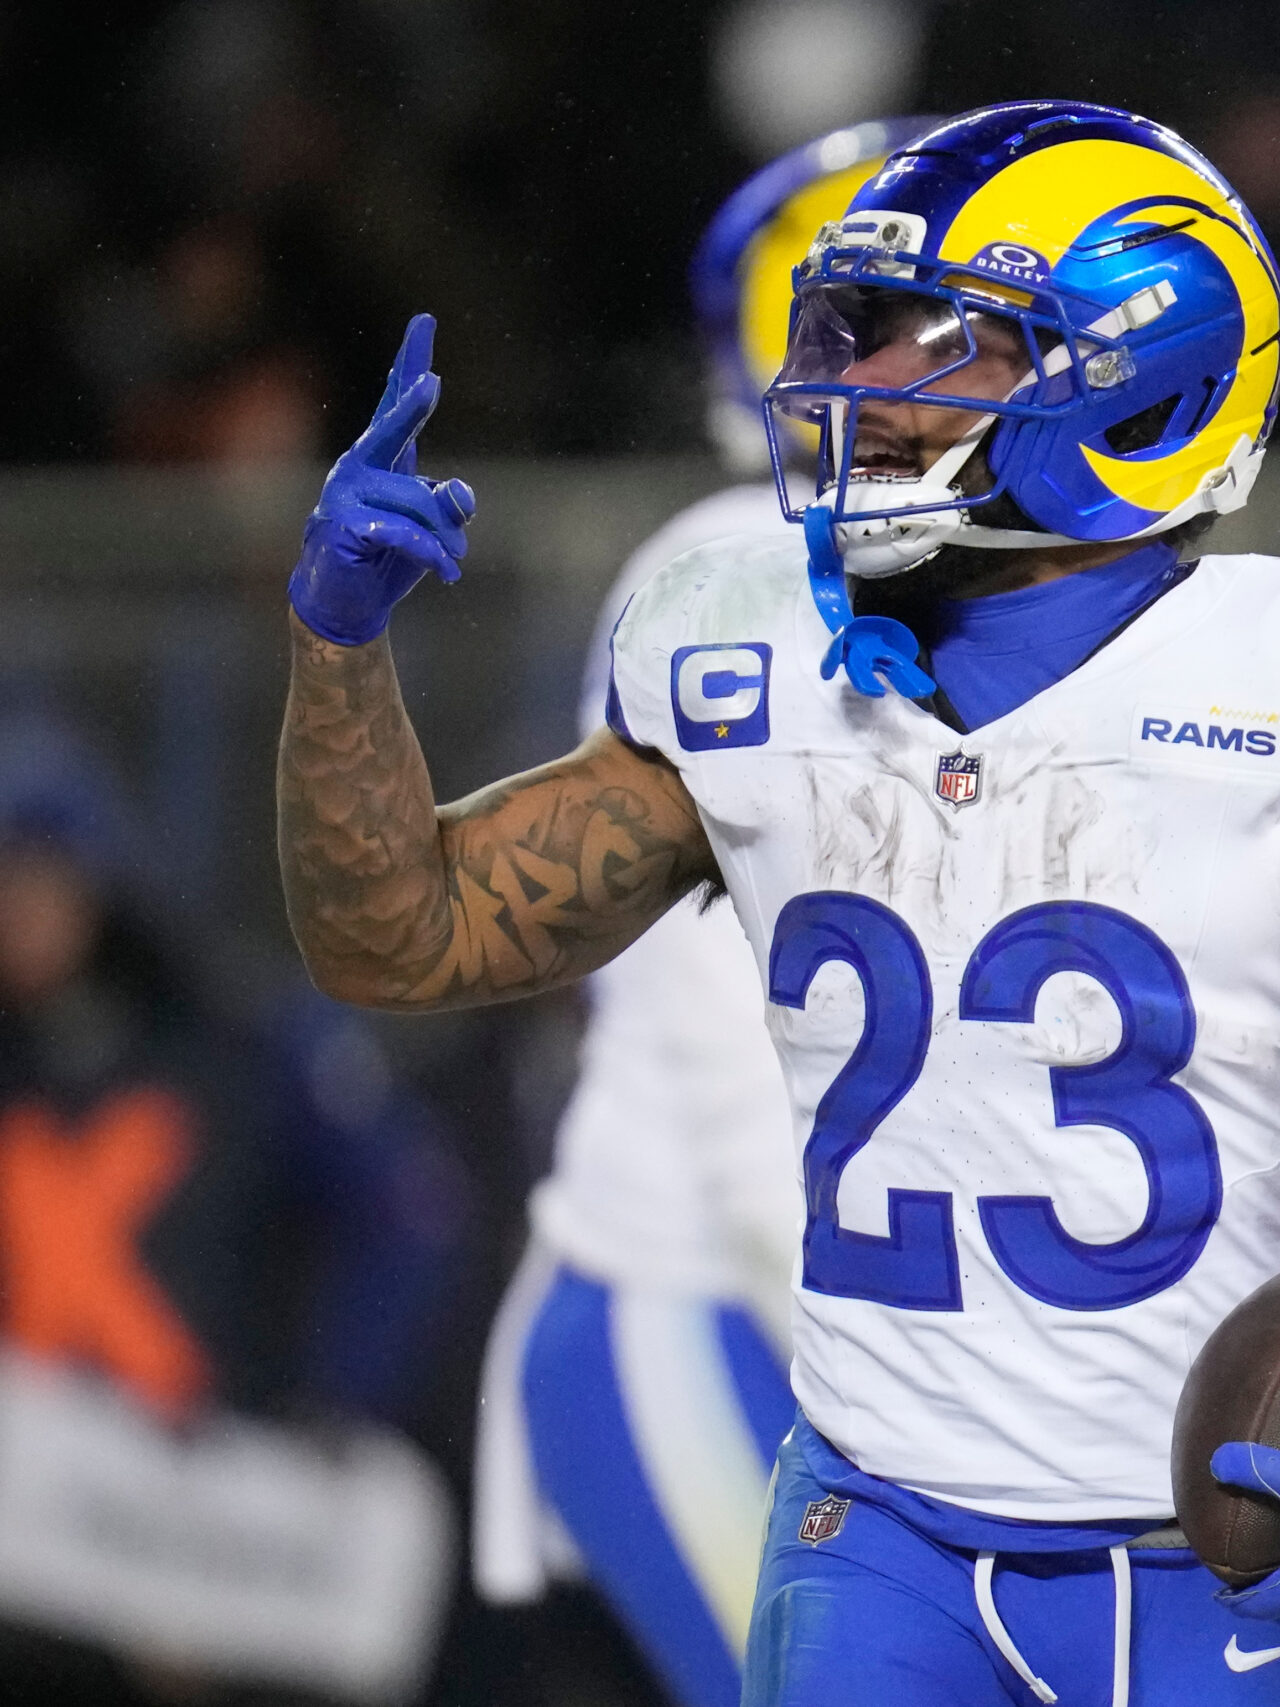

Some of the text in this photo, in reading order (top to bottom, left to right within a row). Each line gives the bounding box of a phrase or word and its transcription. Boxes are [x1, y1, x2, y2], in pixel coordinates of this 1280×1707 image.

[976, 257, 1045, 283] OAKLEY
[678, 648, 763, 723] C
[1141, 717, 1277, 756] RAMS
[940, 773, 974, 800] NFL
[769, 890, 1223, 1312] 23
[803, 1516, 834, 1537] NFL
